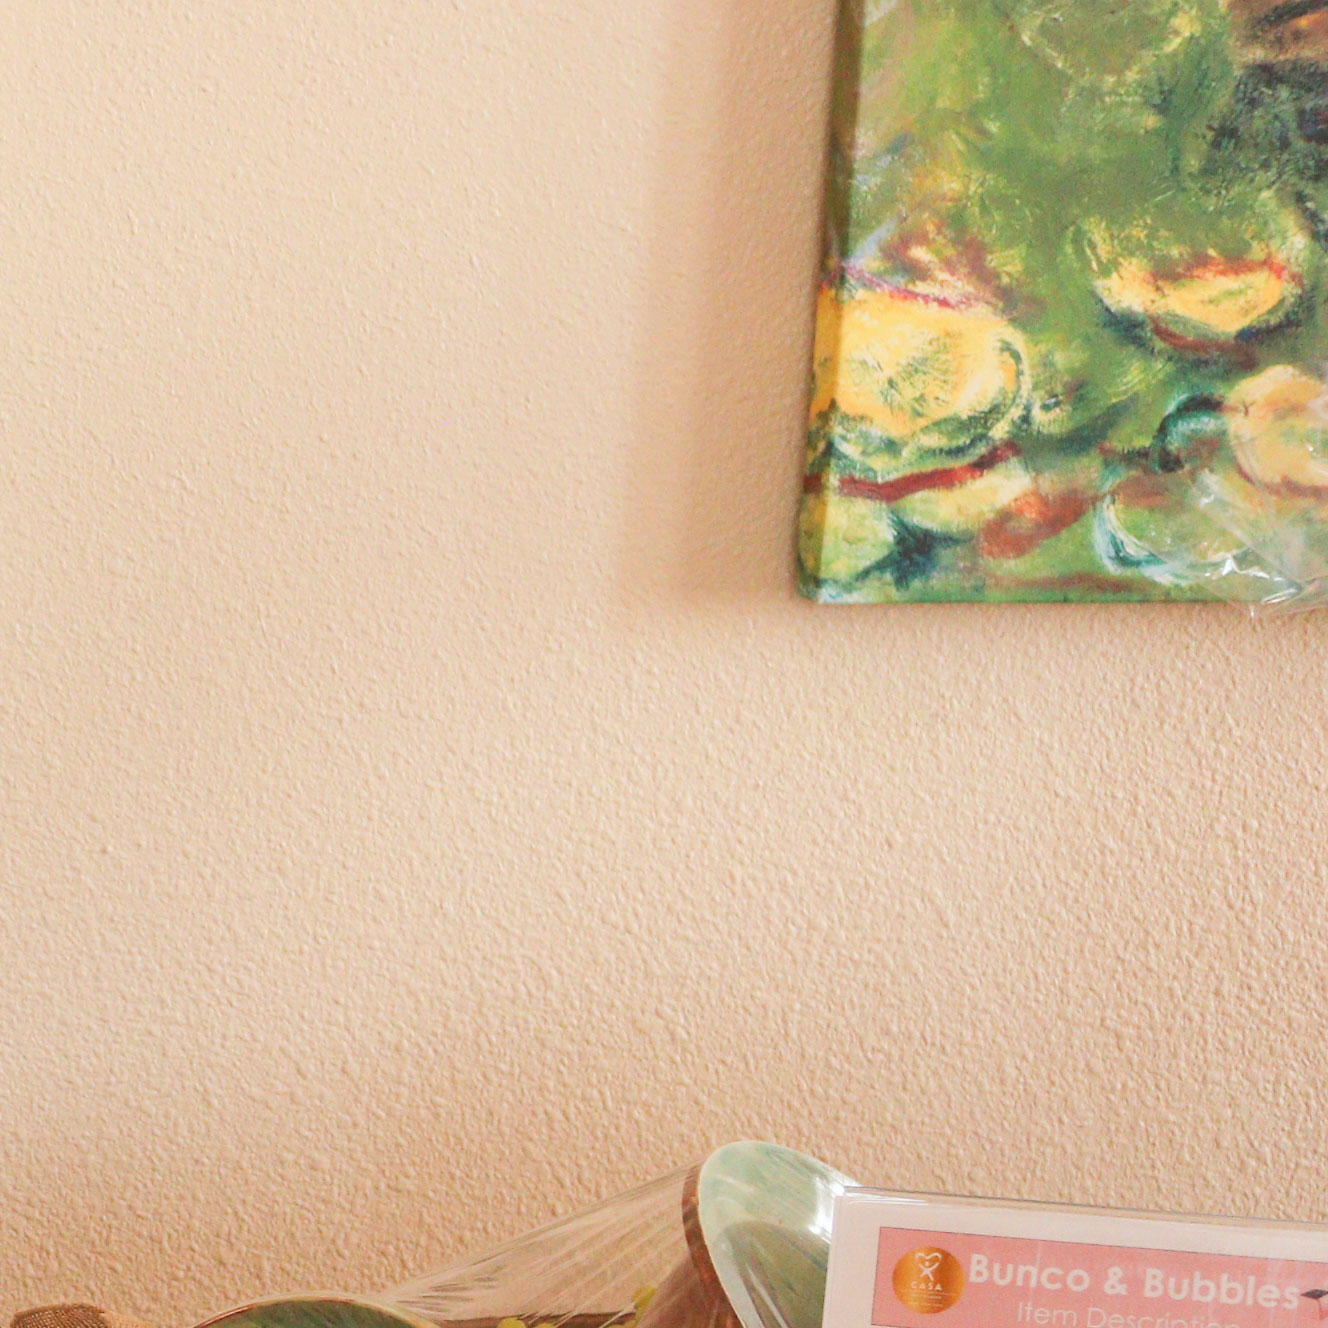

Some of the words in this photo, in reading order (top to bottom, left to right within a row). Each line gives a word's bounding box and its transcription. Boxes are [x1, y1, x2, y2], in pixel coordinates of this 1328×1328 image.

[910, 1281, 942, 1292] CASA
[969, 1254, 1090, 1292] Bunco
[1104, 1266, 1128, 1295] &
[1147, 1267, 1300, 1310] Bubbles
[1017, 1301, 1076, 1327] Item
